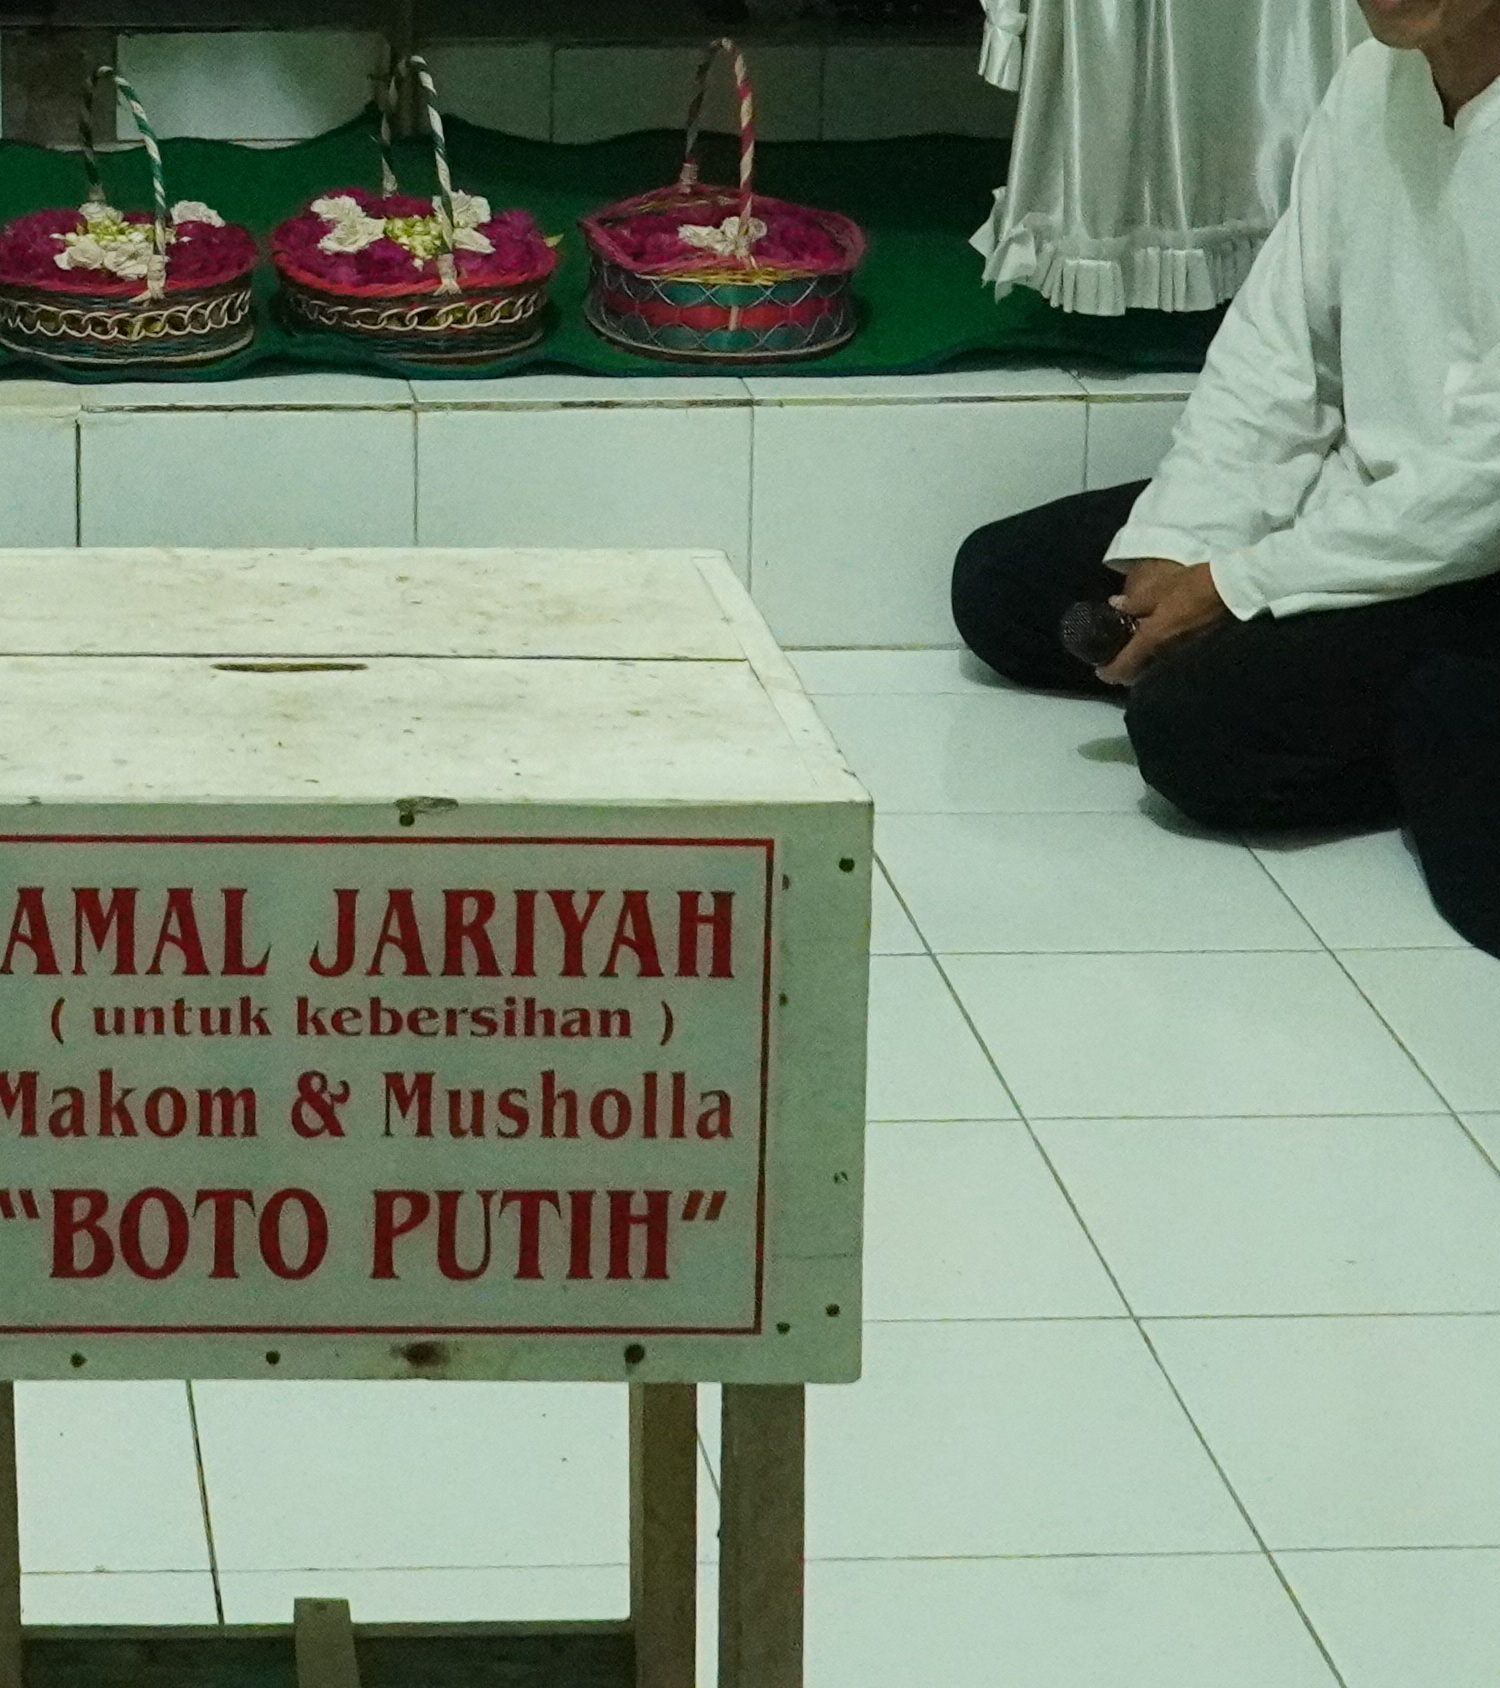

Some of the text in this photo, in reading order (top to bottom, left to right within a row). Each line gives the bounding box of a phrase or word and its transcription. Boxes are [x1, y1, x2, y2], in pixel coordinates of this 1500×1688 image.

[0, 886, 735, 980] AMAL JARIYAH
[92, 997, 272, 1038] untuk
[296, 997, 633, 1040] kebersihan
[290, 1069, 352, 1140] &
[383, 1069, 734, 1141] Musholla
[370, 1188, 728, 1282] PUTIH"
